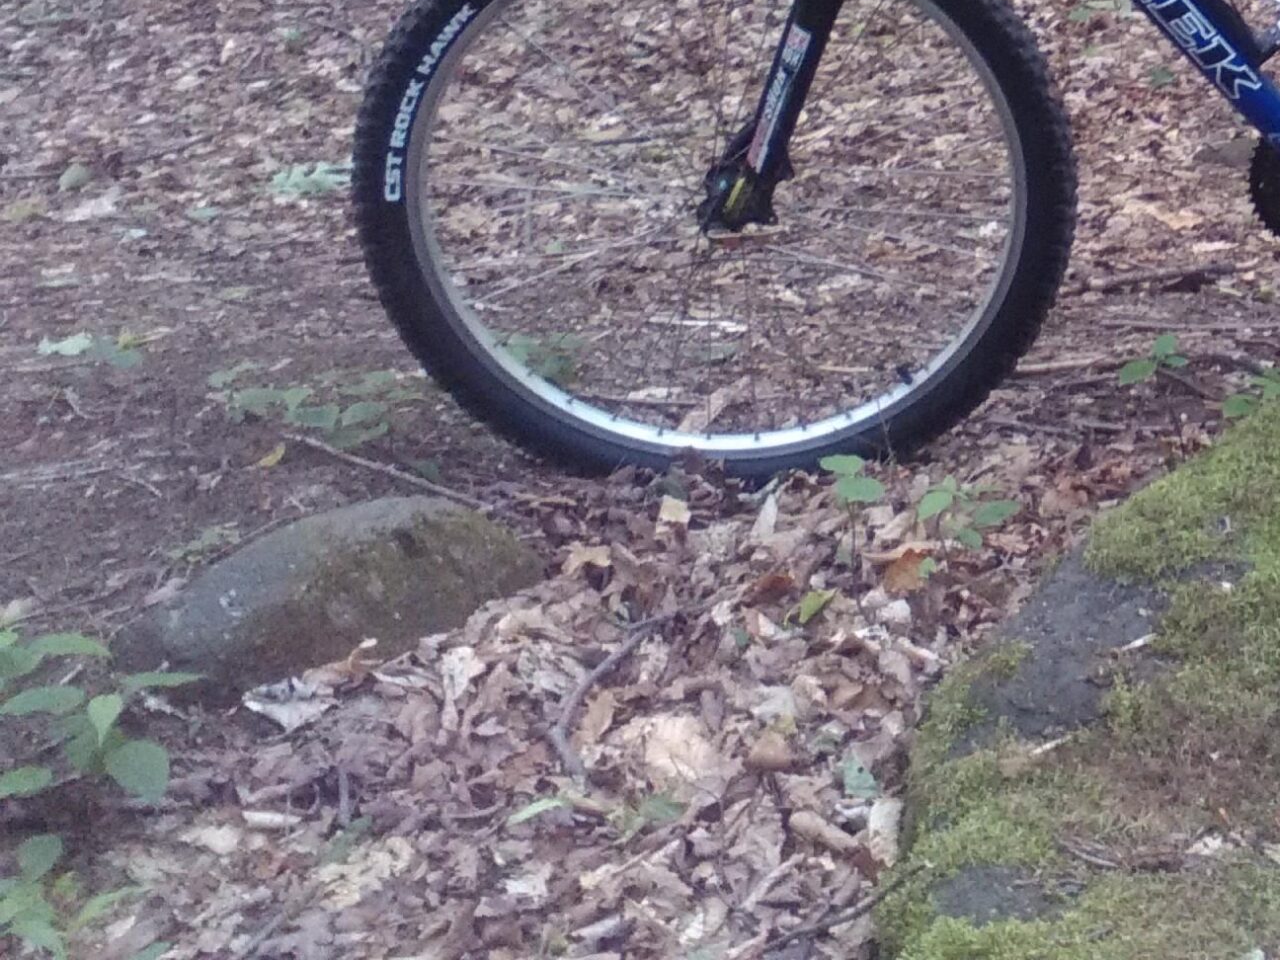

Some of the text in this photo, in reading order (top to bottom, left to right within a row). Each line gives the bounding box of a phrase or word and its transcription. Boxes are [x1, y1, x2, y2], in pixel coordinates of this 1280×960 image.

[384, 2, 477, 202] CST ROCK HAWK
